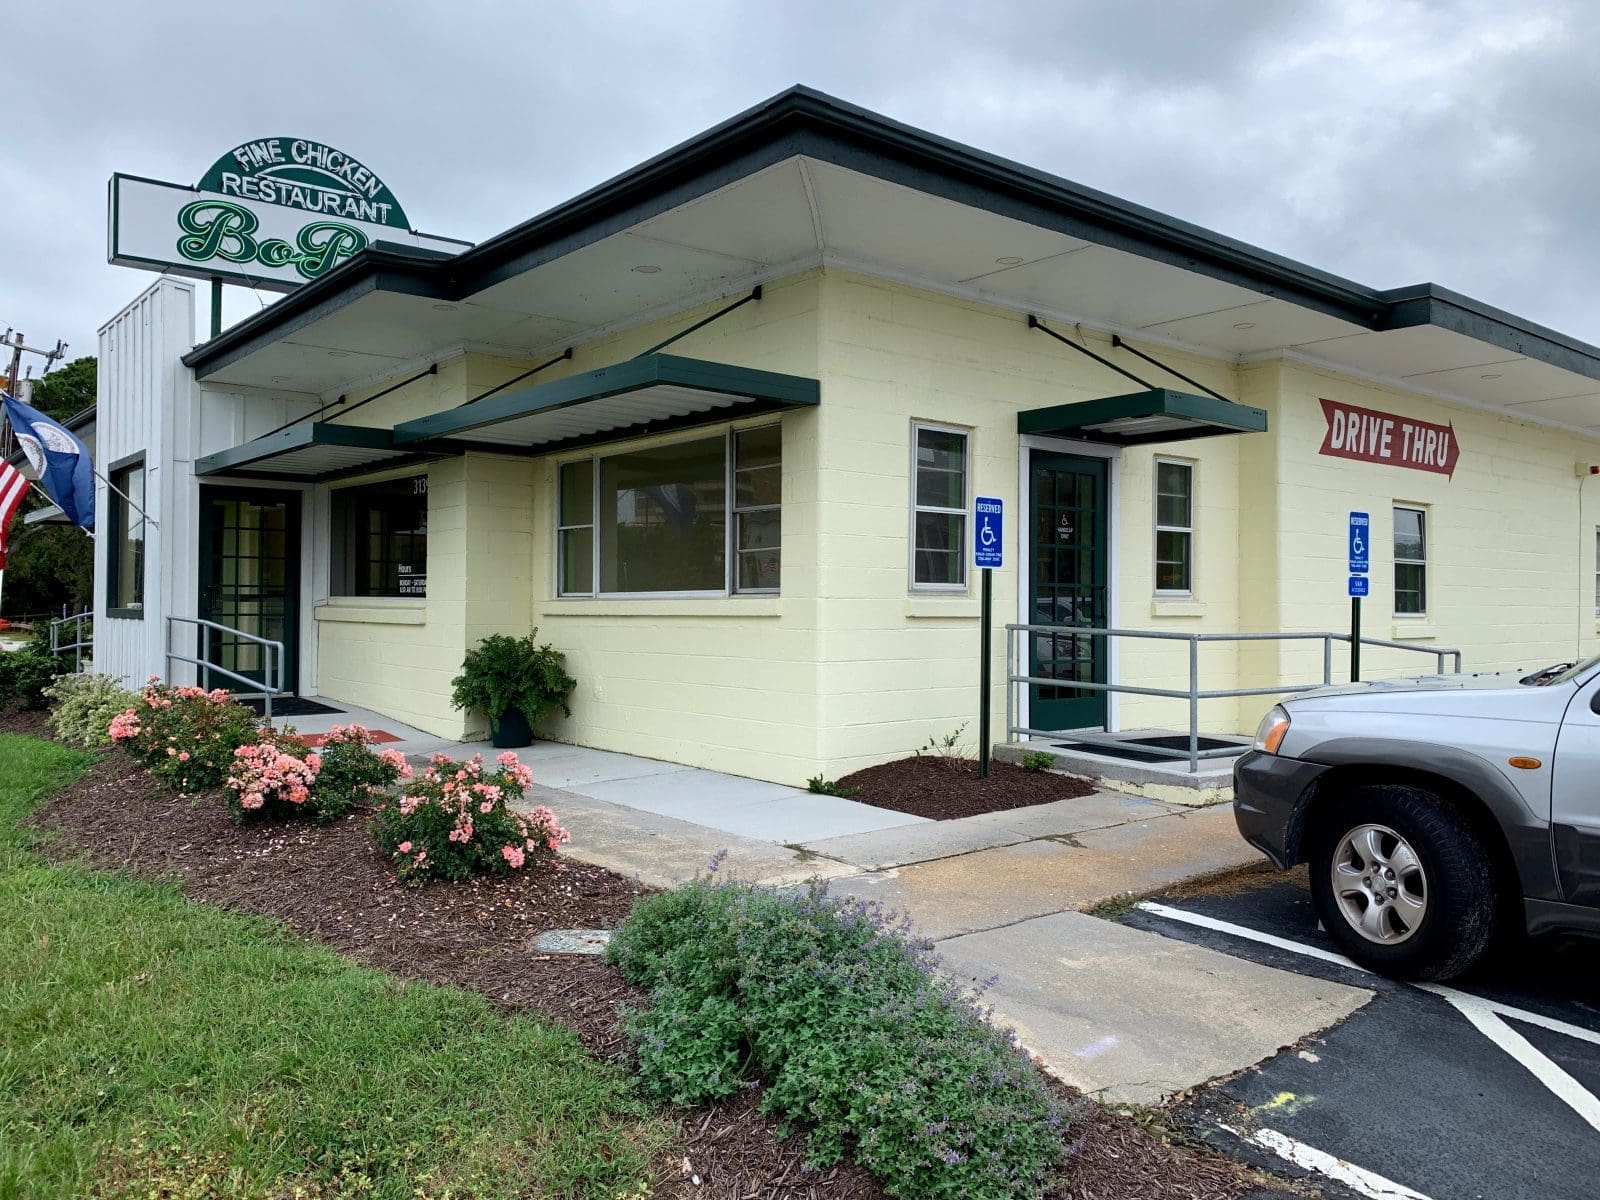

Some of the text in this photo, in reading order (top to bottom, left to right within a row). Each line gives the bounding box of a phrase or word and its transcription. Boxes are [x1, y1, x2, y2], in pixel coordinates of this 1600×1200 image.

[233, 139, 382, 198] FINE CHICKEN
[221, 172, 392, 224] RESTAURANT
[1330, 408, 1449, 468] DRIVE THRU
[977, 503, 1001, 513] RESERVED
[398, 563, 412, 573] Hours
